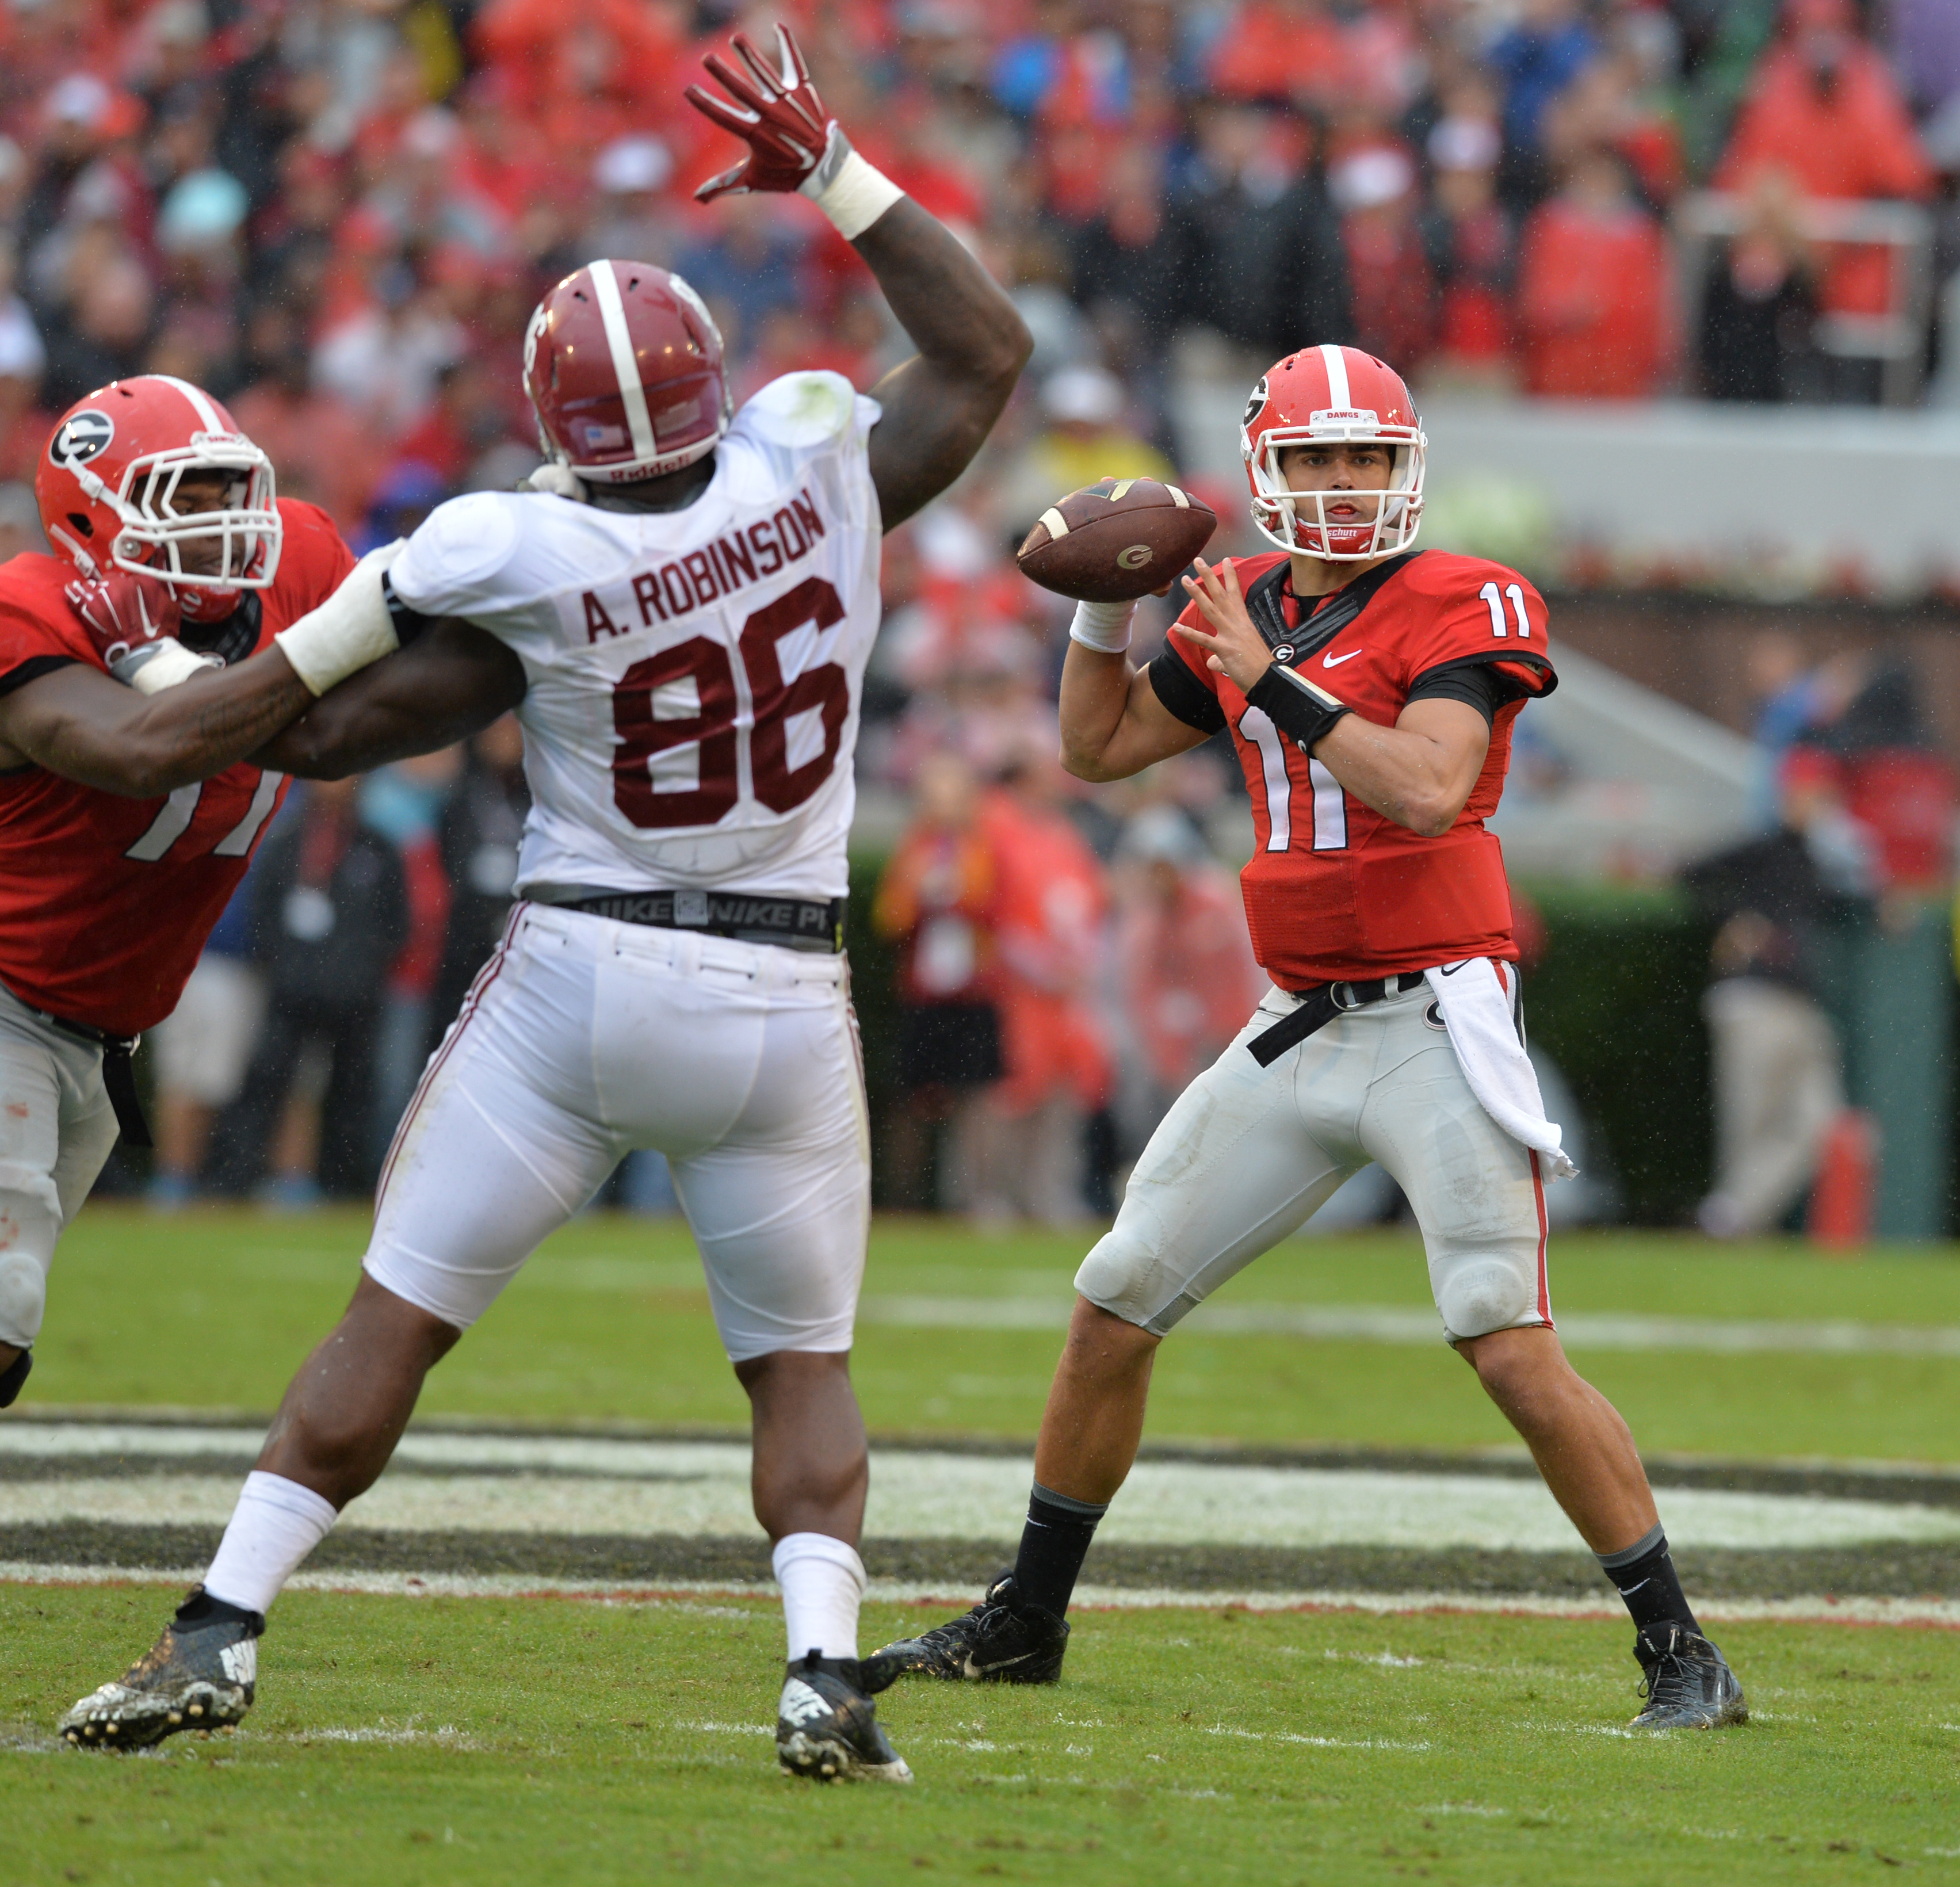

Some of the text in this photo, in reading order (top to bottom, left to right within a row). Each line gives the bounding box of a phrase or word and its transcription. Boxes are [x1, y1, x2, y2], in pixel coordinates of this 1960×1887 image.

[610, 453, 691, 482] Riddell
[1327, 528, 1358, 537] schutt
[582, 488, 825, 644] A. ROBINSON
[1117, 544, 1153, 570] G
[1478, 581, 1530, 639] 11
[1276, 648, 1294, 660] G
[611, 576, 850, 828] 86
[1238, 705, 1349, 853] 11
[581, 897, 674, 922] NIKE
[708, 899, 794, 927] NIKE
